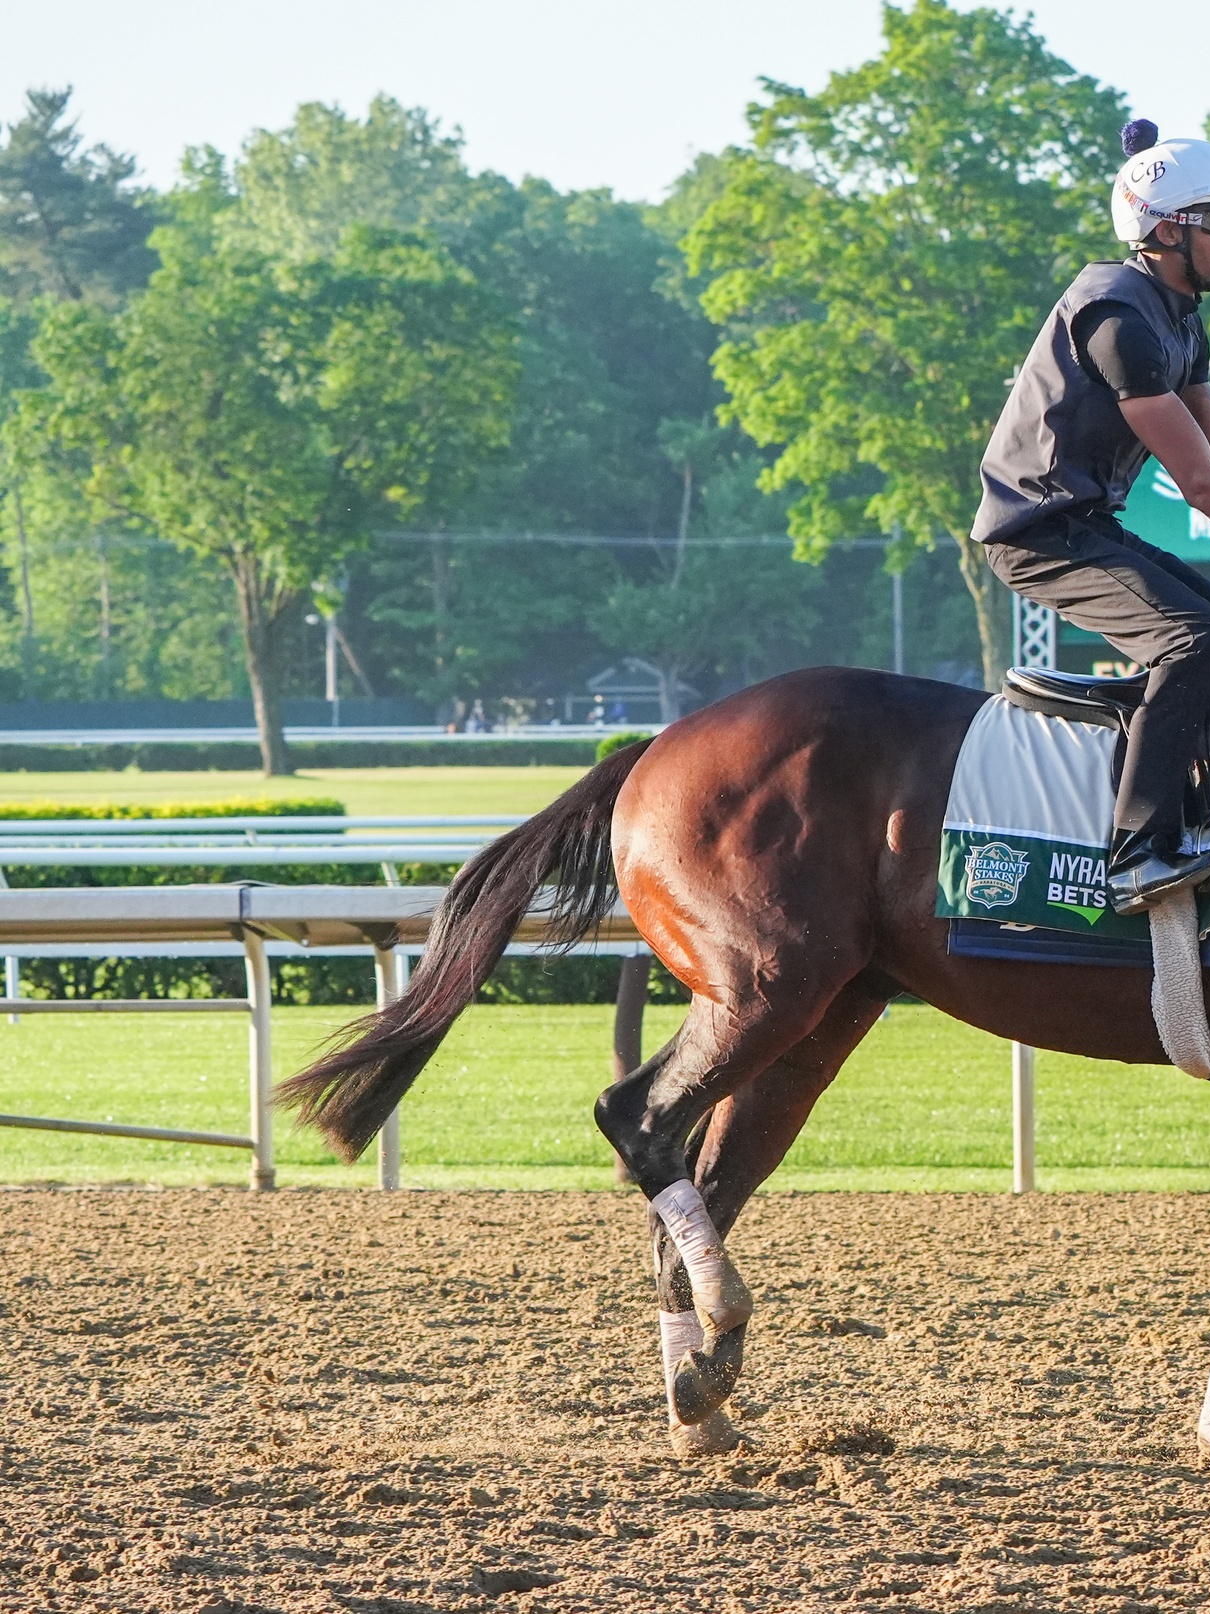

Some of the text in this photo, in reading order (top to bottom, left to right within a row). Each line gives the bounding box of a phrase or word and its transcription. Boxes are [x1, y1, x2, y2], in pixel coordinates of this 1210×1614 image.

[968, 858, 1025, 874] BELMONT
[1050, 852, 1106, 887] NYRA
[975, 869, 1014, 884] STAKES
[1047, 883, 1107, 908] BETS
